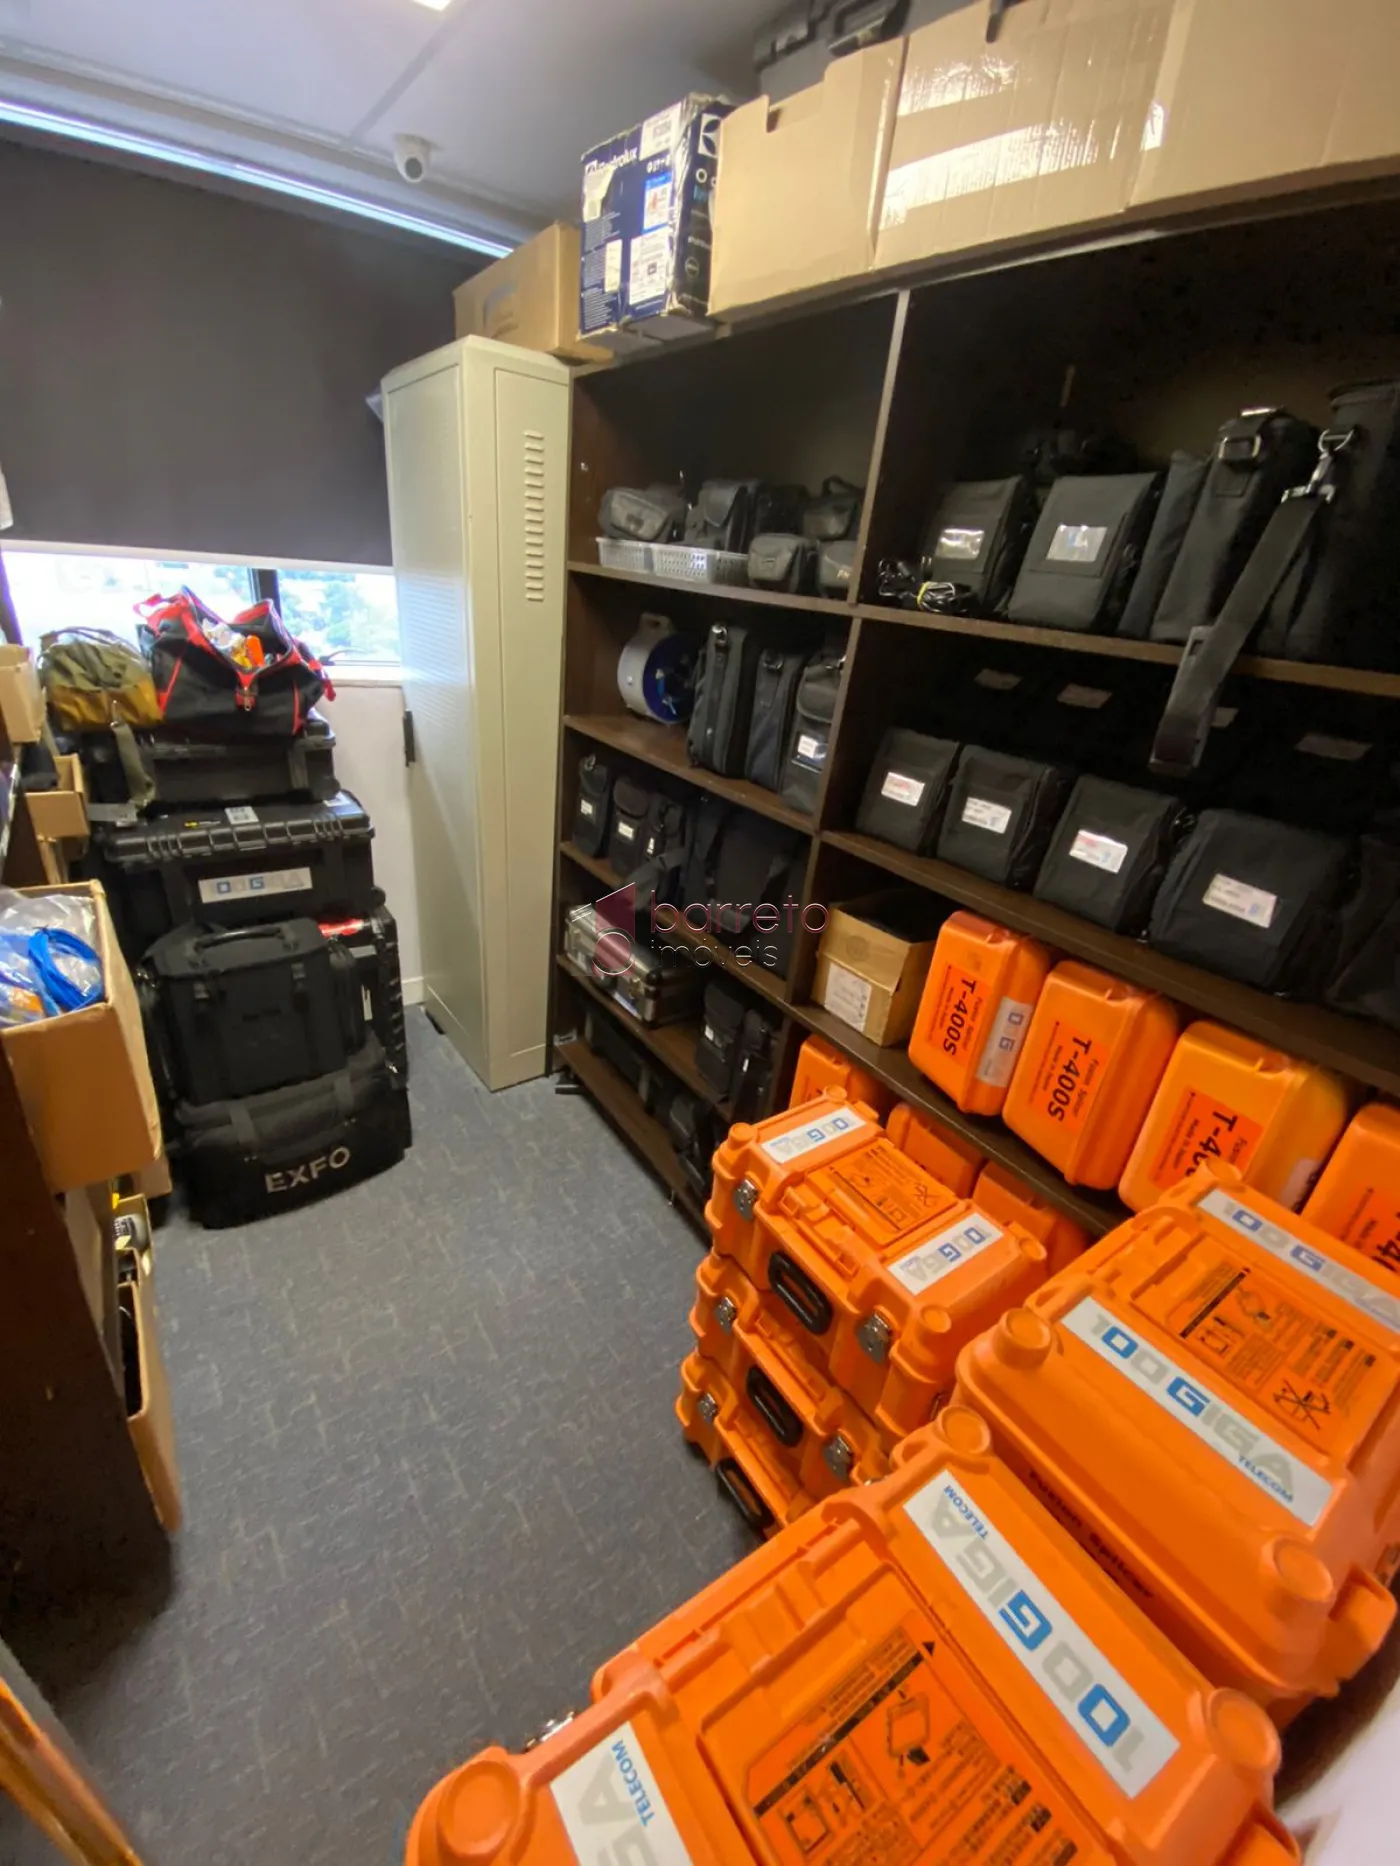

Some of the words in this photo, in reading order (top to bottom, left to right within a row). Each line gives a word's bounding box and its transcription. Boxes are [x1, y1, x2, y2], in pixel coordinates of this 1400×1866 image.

[943, 978, 977, 1056] T-400S
[1047, 1037, 1092, 1122] T-400S
[265, 1147, 351, 1194] EXFO
[944, 1484, 989, 1540] TELECOM
[1238, 1455, 1294, 1503] TELECOM
[611, 1739, 655, 1827] TELECOM
